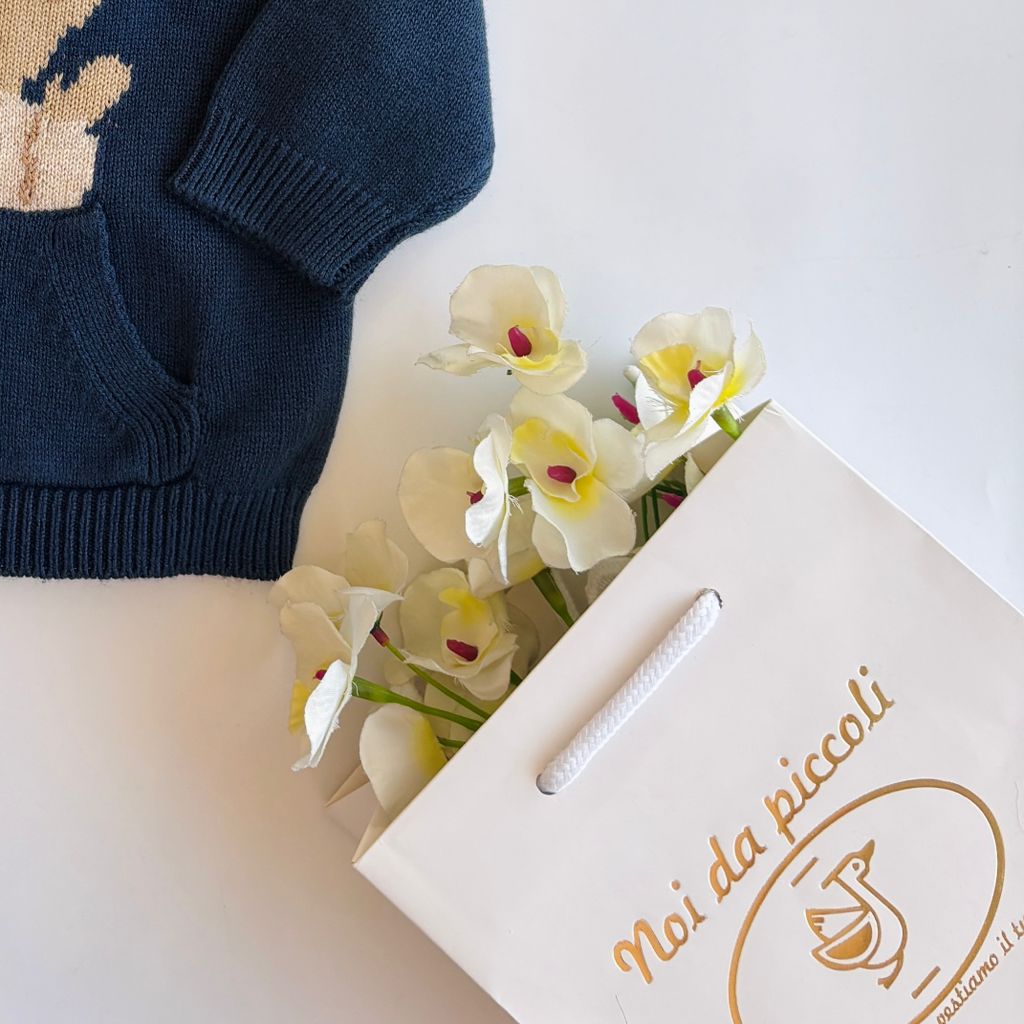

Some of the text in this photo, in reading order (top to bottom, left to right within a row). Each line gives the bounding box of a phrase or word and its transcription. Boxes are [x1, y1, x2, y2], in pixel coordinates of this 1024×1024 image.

[613, 665, 896, 985] Noi da piccoli
[996, 930, 1014, 956] il
